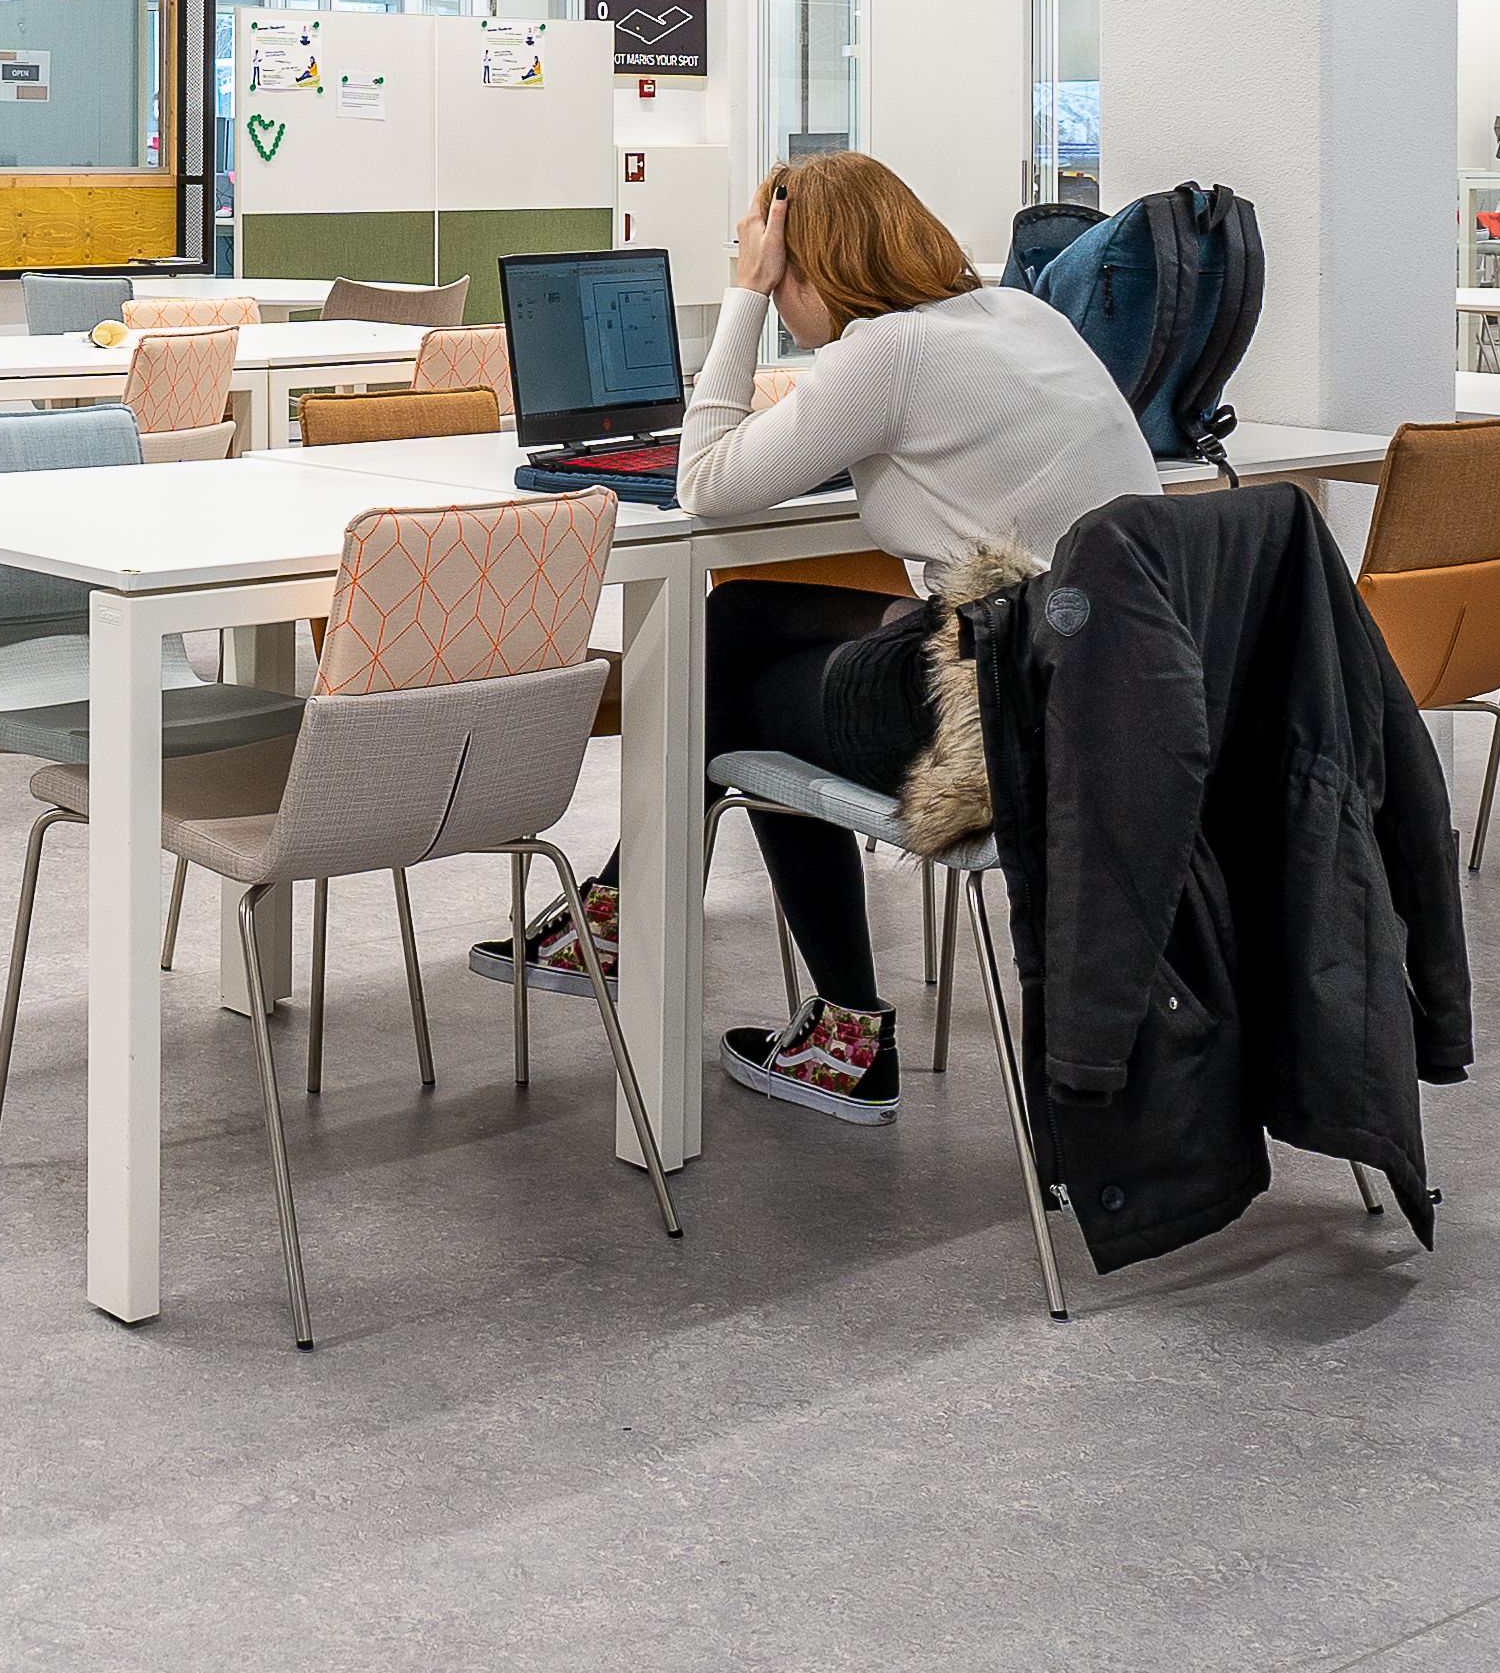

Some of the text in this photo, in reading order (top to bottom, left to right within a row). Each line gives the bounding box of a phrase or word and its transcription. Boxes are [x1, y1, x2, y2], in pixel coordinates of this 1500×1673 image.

[614, 53, 699, 67] OT MARKS YOUR SPOT
[11, 69, 29, 77] OPEN
